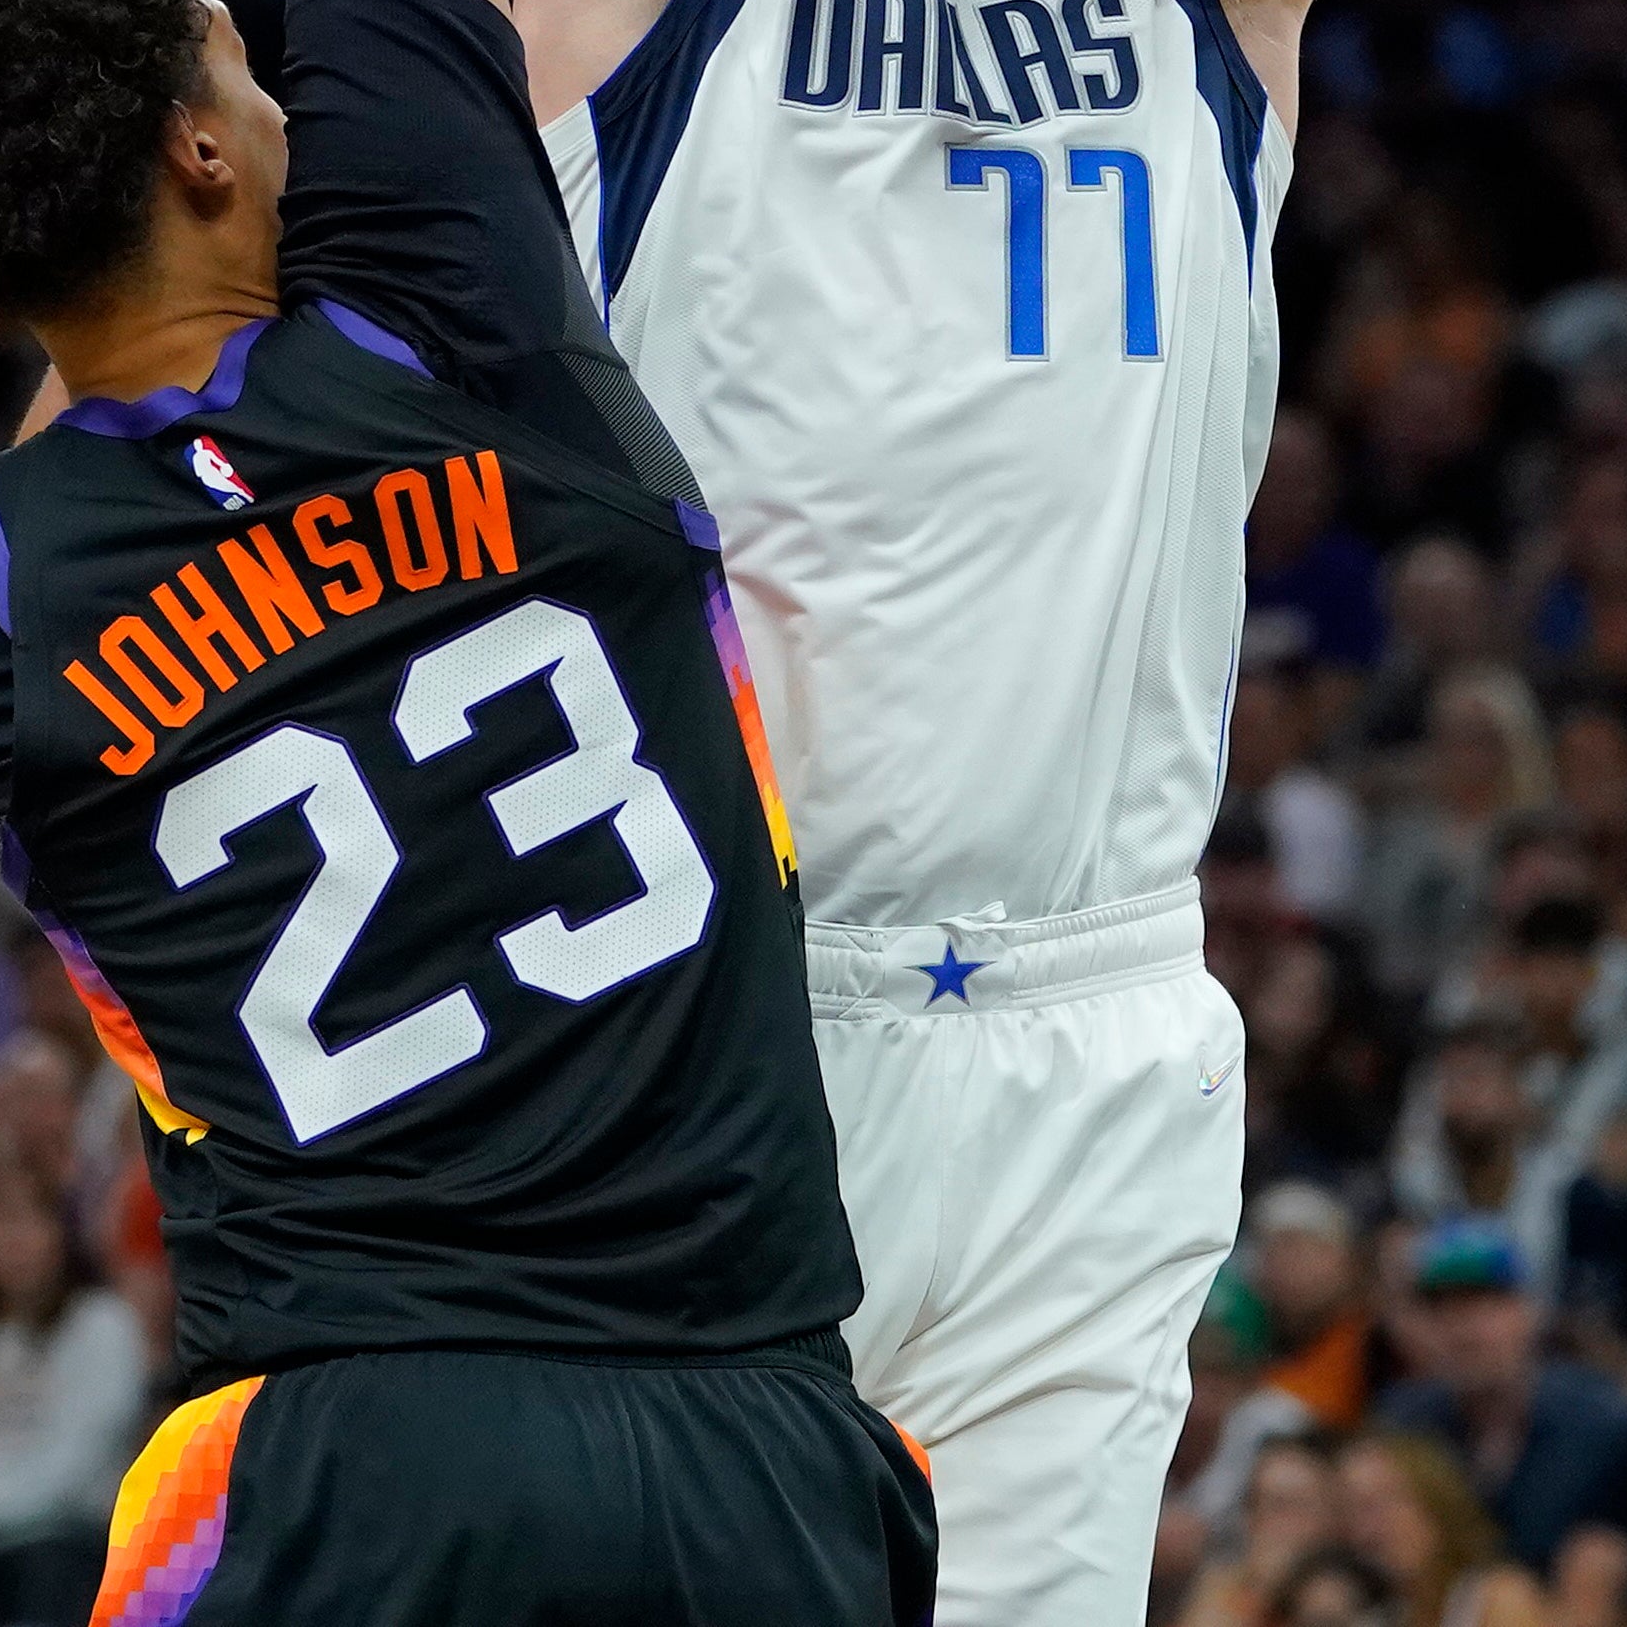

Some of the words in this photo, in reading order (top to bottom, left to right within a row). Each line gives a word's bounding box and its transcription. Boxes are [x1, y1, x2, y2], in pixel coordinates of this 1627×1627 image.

[944, 143, 1165, 362] 77
[63, 450, 519, 776] JOHNSON
[149, 594, 718, 1148] 23
